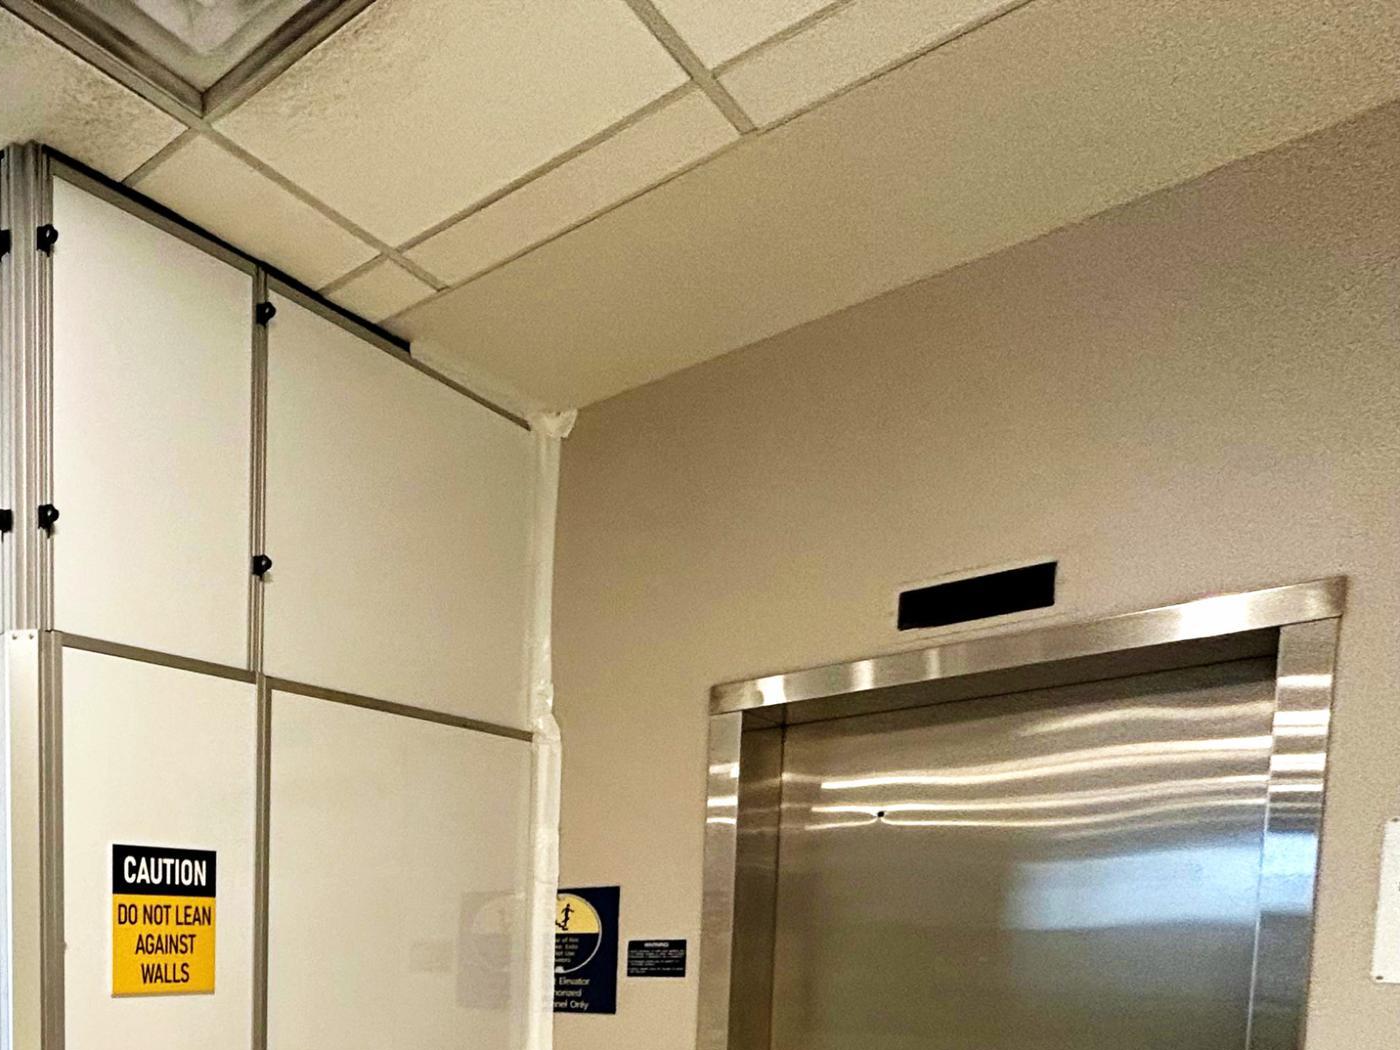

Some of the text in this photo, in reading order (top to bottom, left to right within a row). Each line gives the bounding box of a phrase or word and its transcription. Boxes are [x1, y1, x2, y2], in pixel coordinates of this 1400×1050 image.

[123, 855, 207, 886] CAUTION
[118, 904, 211, 926] DO NOT LEAN
[135, 934, 197, 955] AGAINST
[141, 962, 190, 984] WALLS
[569, 1000, 589, 1011] Only
